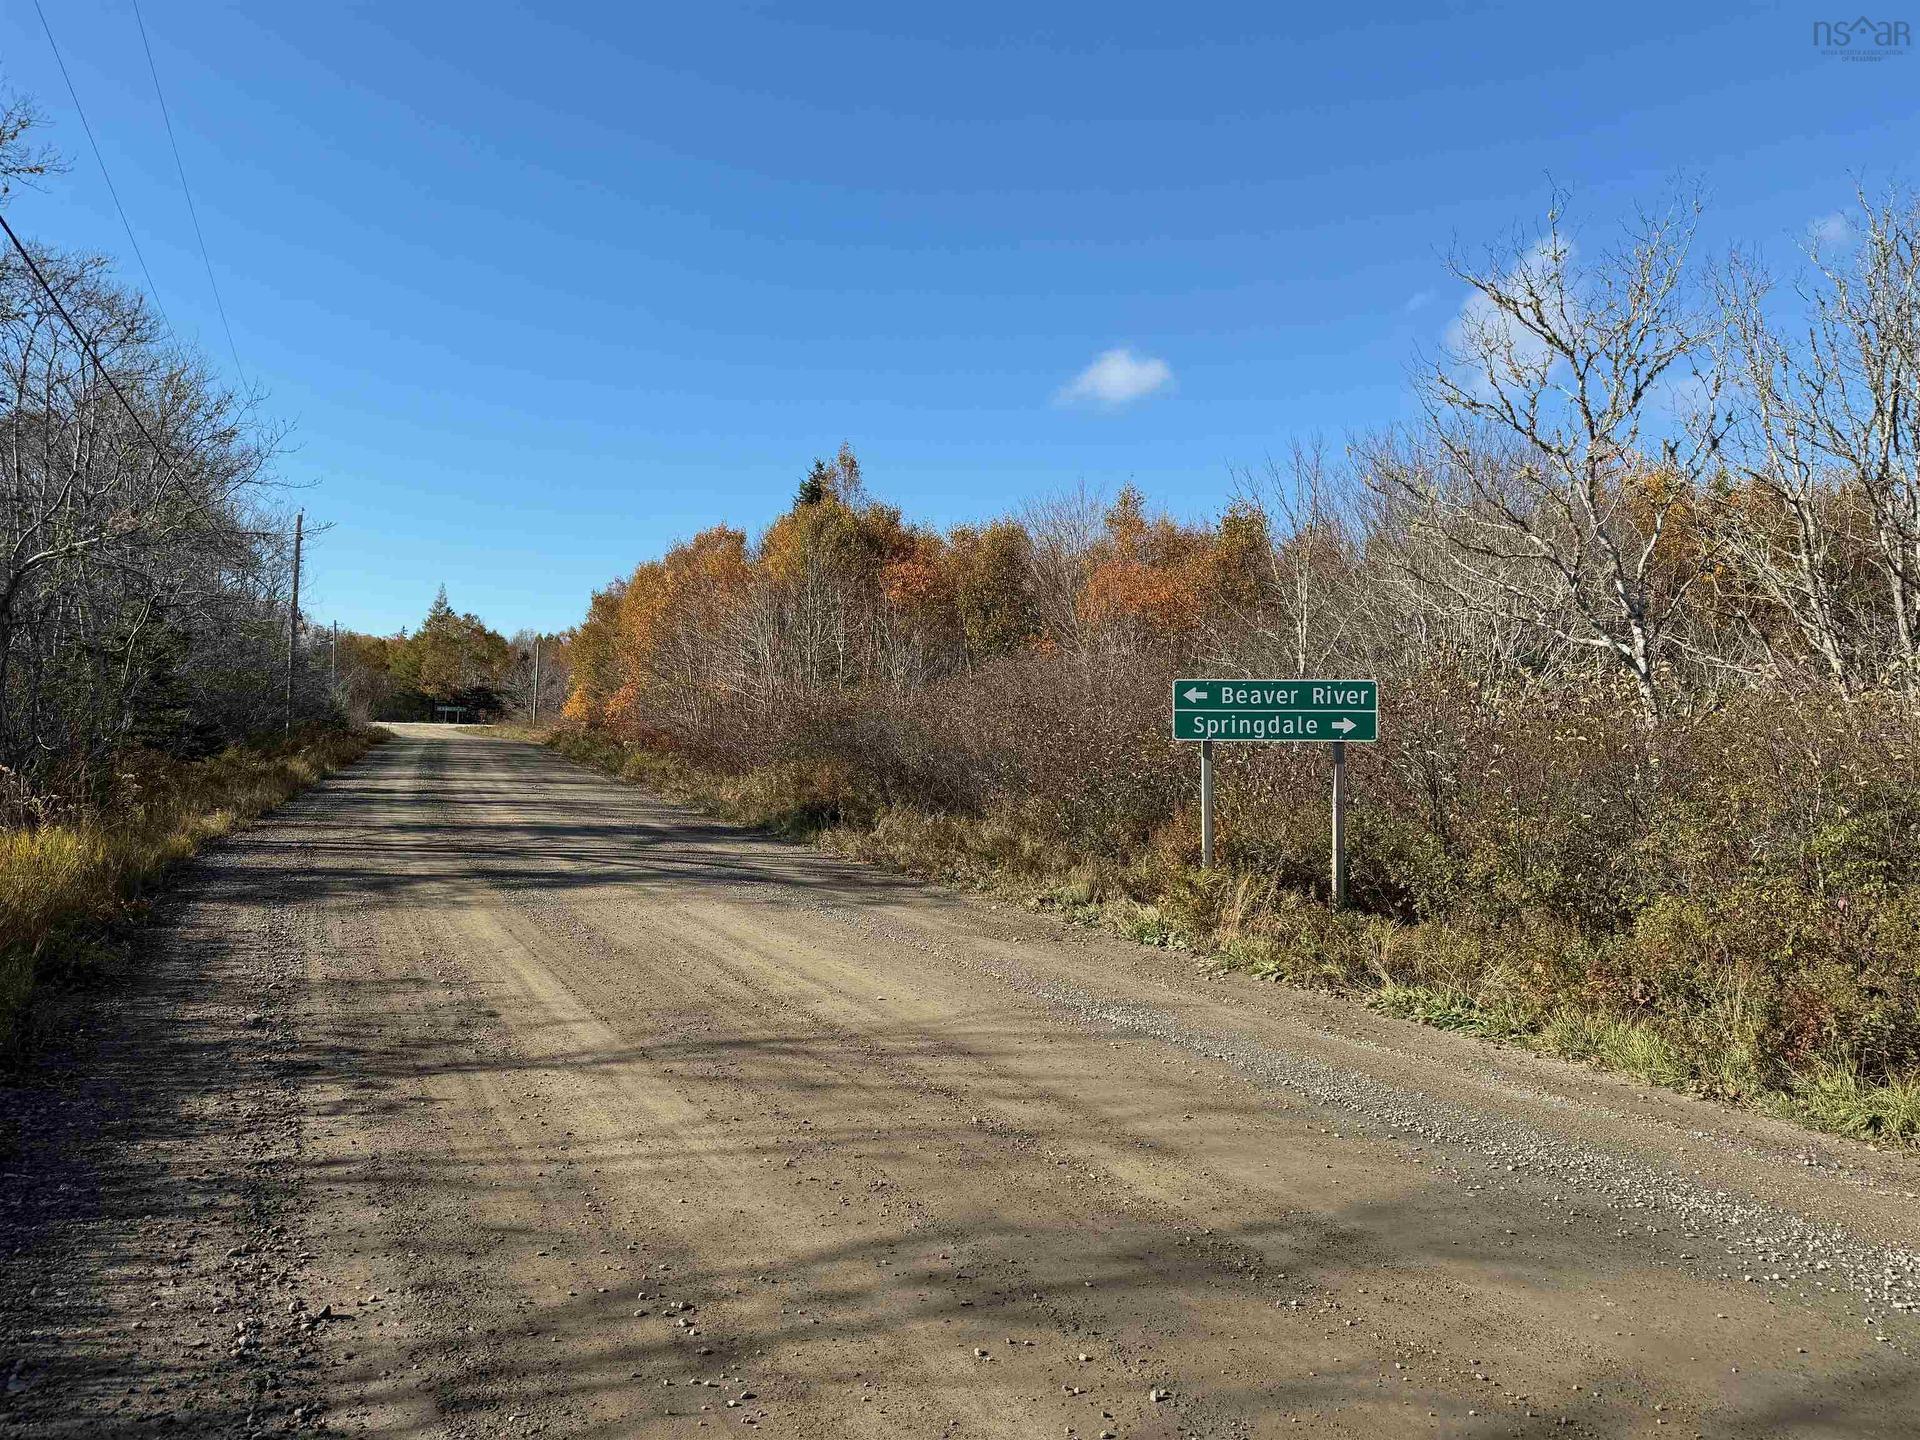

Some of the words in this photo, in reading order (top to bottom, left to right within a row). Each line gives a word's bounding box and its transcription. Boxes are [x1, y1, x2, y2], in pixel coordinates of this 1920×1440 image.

[1221, 686, 1298, 704] Beaver
[1312, 685, 1369, 704] River
[1193, 714, 1318, 738] Springdale
